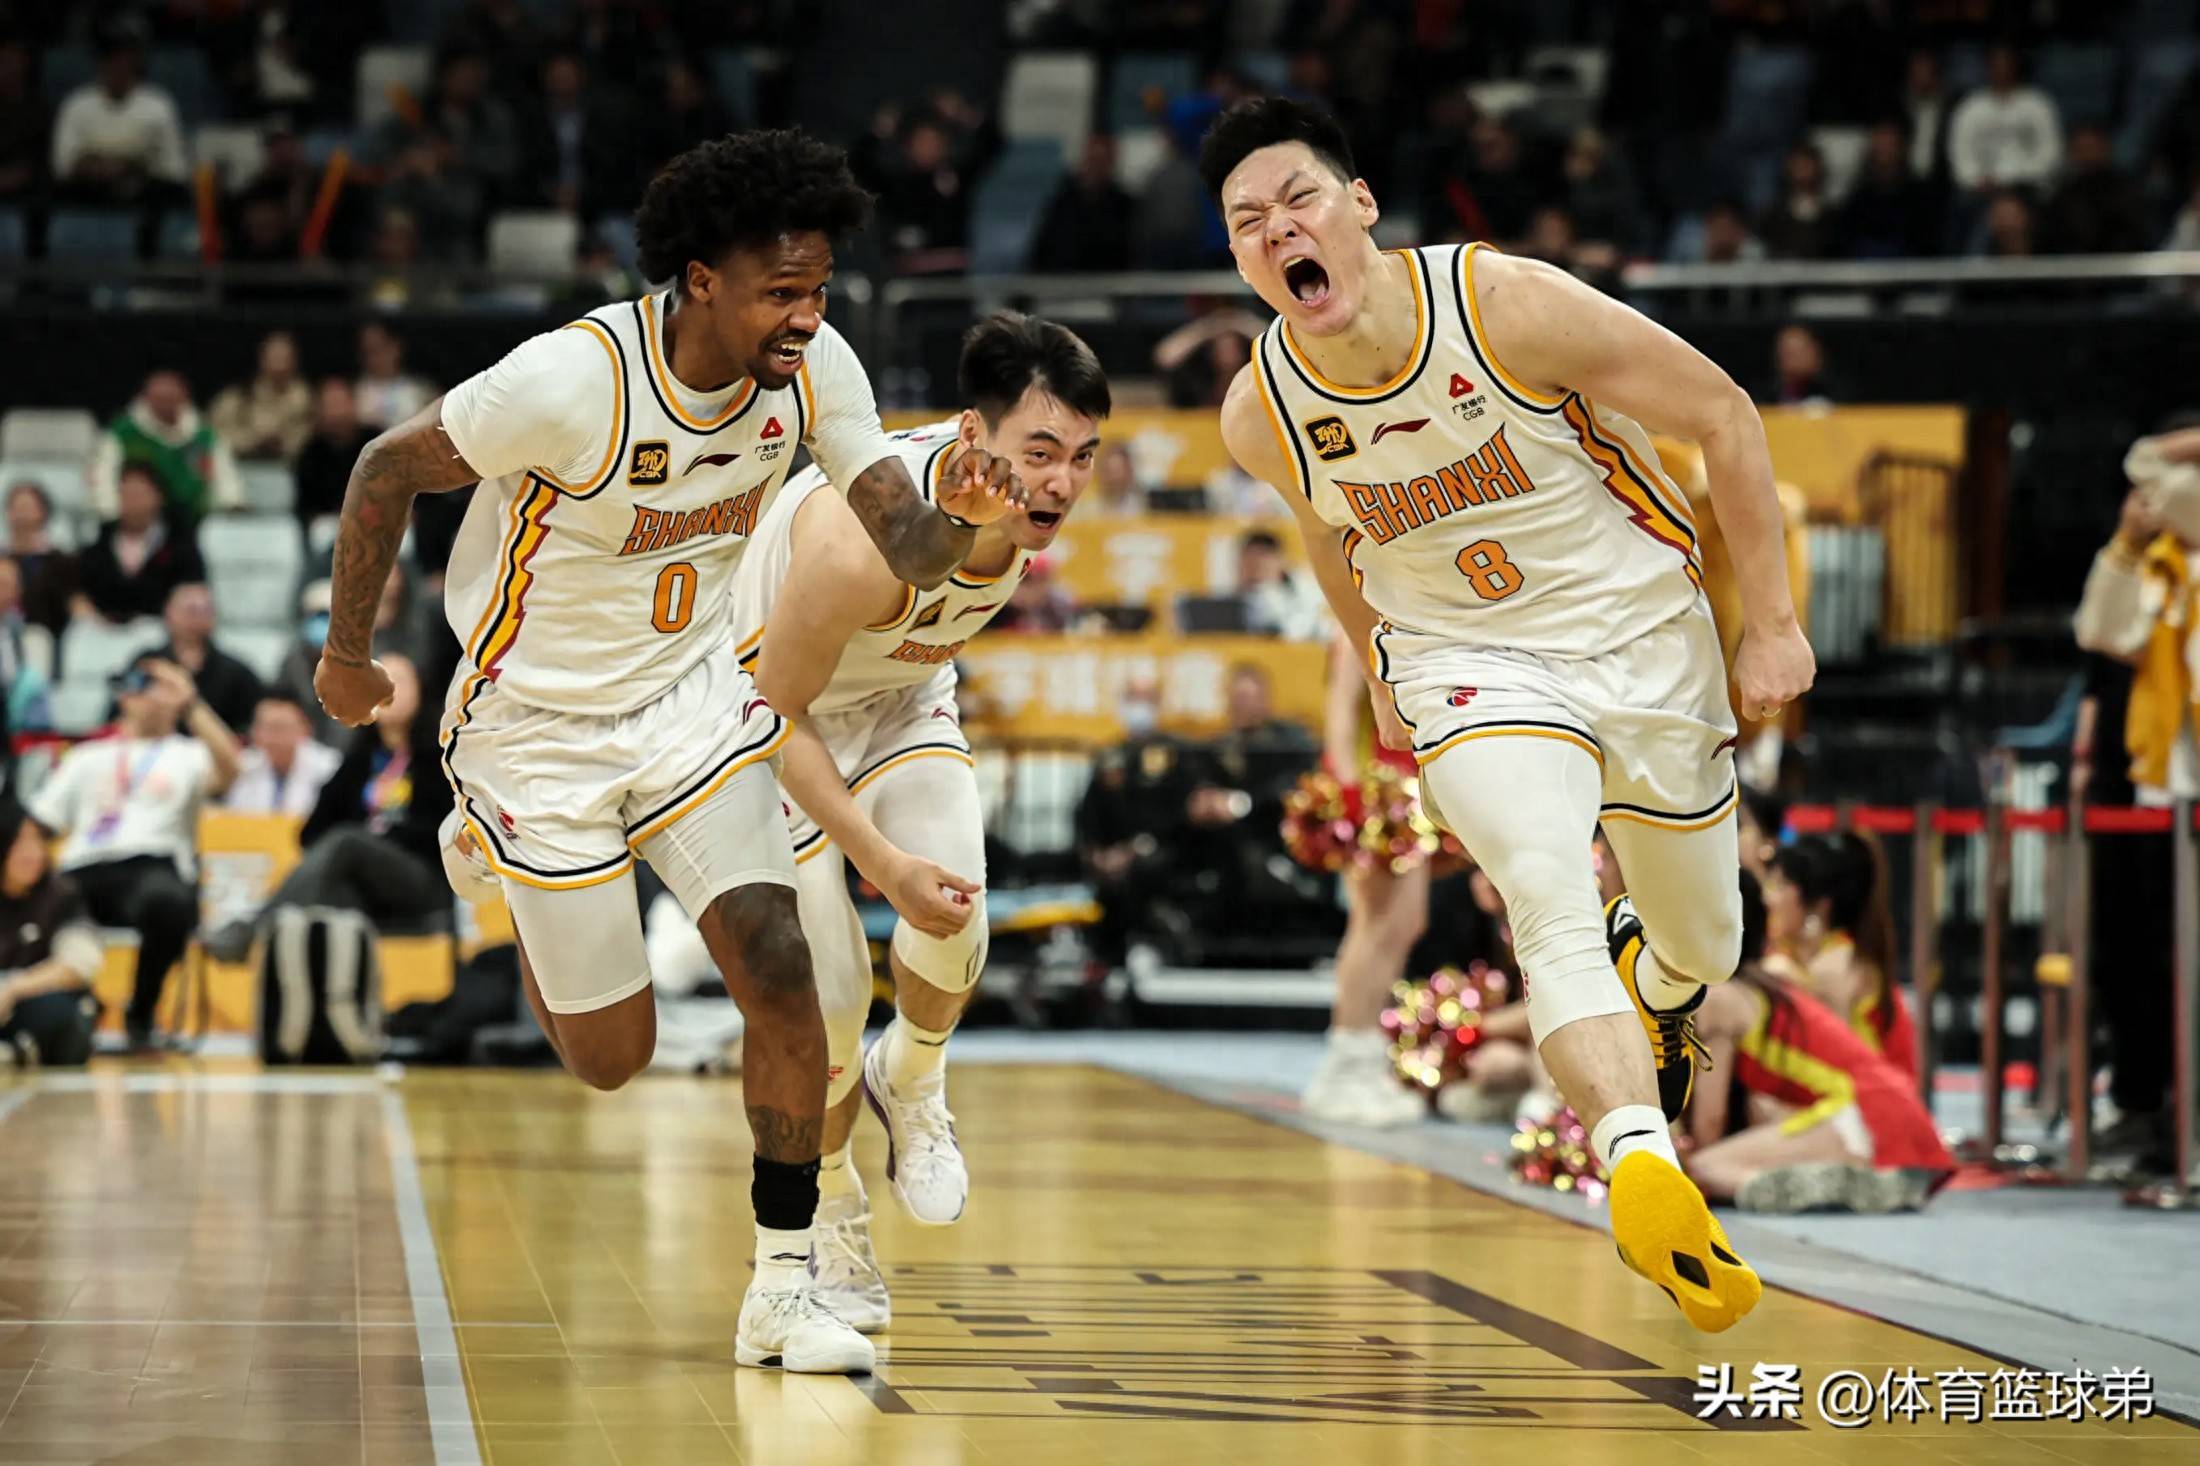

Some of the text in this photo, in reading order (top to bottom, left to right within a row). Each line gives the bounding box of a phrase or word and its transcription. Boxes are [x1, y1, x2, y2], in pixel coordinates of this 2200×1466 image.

[1463, 407, 1485, 421] CGB
[760, 451, 779, 462] CGB
[1330, 421, 1536, 546] SHANXI
[617, 469, 776, 556] SHANXI
[650, 561, 698, 634] 0
[1454, 538, 1525, 601] 8
